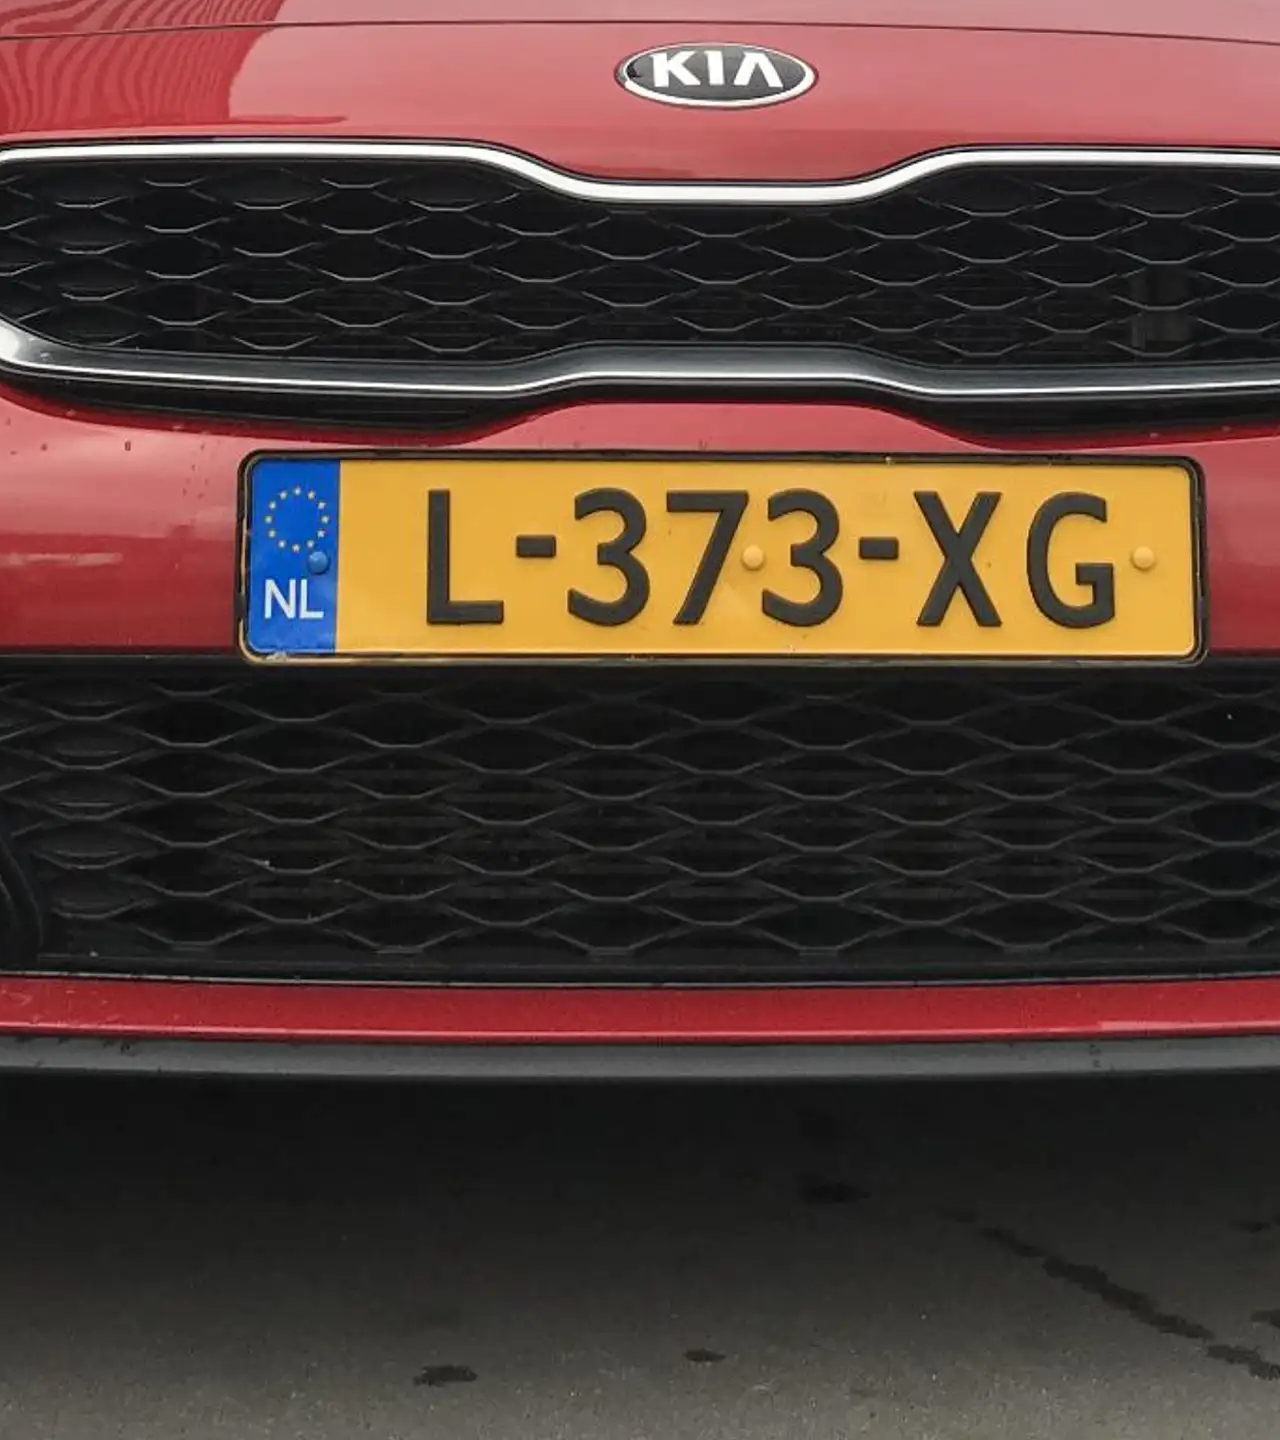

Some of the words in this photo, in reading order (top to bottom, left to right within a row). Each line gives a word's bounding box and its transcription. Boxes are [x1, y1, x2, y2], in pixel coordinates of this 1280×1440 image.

[650, 50, 784, 88] KIA
[426, 488, 1117, 630] L-373-XG
[264, 578, 325, 620] NL
